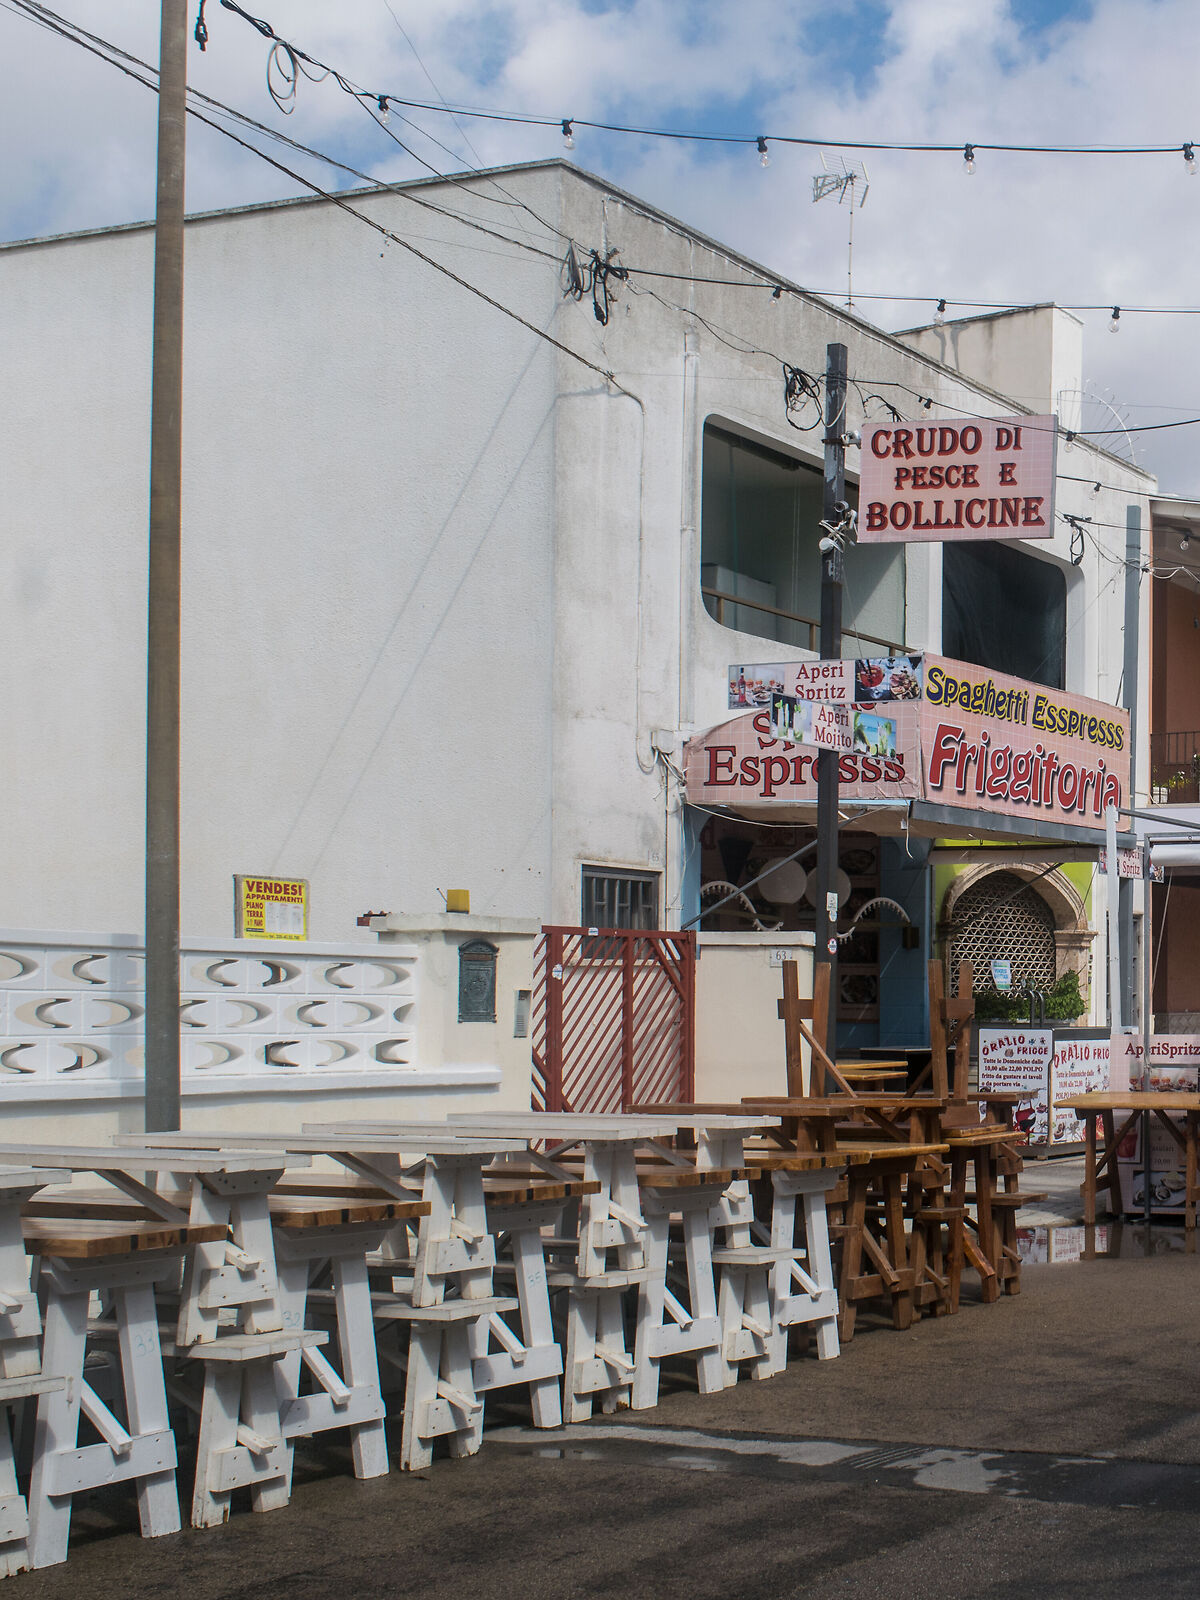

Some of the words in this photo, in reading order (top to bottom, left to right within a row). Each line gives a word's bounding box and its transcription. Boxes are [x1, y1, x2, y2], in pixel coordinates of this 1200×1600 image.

[871, 426, 982, 459] CRUDO
[995, 427, 1022, 451] DI
[894, 465, 980, 490] PESCE
[999, 463, 1018, 486] E
[866, 497, 1046, 531] BOLLICINE
[796, 661, 844, 683] Aperi
[795, 683, 846, 700] Spritz
[818, 705, 849, 727] Aperi
[926, 665, 1030, 724] Spaghetti
[1032, 694, 1124, 749] Esspresss
[814, 725, 852, 749] Mojito
[929, 723, 1121, 815] Friggitoria
[246, 880, 303, 896] VENDESI
[246, 893, 303, 903] APPARTAMENTI
[246, 901, 264, 909] PIANO
[246, 910, 264, 918] TERRA
[776, 950, 787, 960] 63
[982, 1034, 1025, 1055] ORAZIO
[1054, 1043, 1090, 1068] ORAZIO
[1125, 1042, 1200, 1059] ApriSpritz
